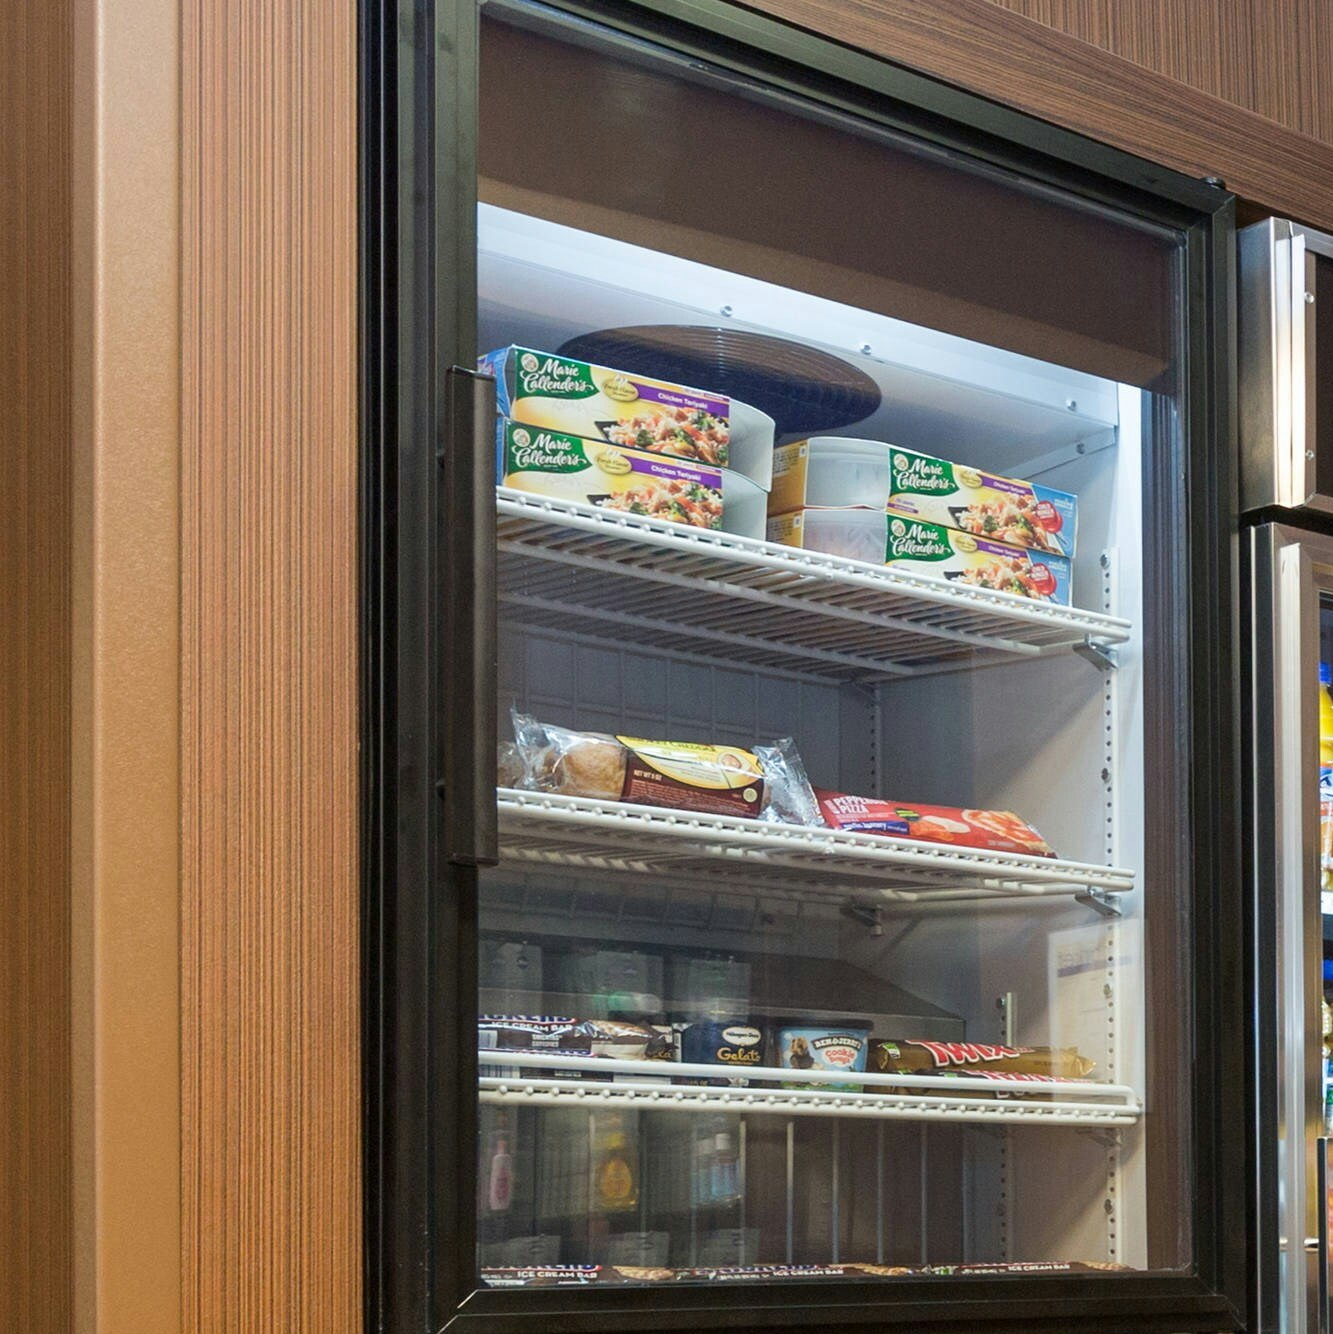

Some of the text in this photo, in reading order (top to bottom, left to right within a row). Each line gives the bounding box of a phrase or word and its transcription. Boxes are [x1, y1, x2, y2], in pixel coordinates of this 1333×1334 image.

[538, 359, 579, 377] Marie
[520, 371, 594, 392] Callender's
[530, 434, 572, 451] Marie
[512, 446, 587, 467] Callender's
[908, 459, 943, 476] Marie
[893, 470, 956, 489] Callender's
[904, 524, 939, 540] Marie
[890, 535, 952, 554] Callender's
[839, 804, 869, 814] PIZZA
[512, 1022, 548, 1032] CREAM
[551, 1023, 573, 1031] BAR
[905, 1040, 1019, 1067] TWIX
[536, 1271, 574, 1279] CREAM
